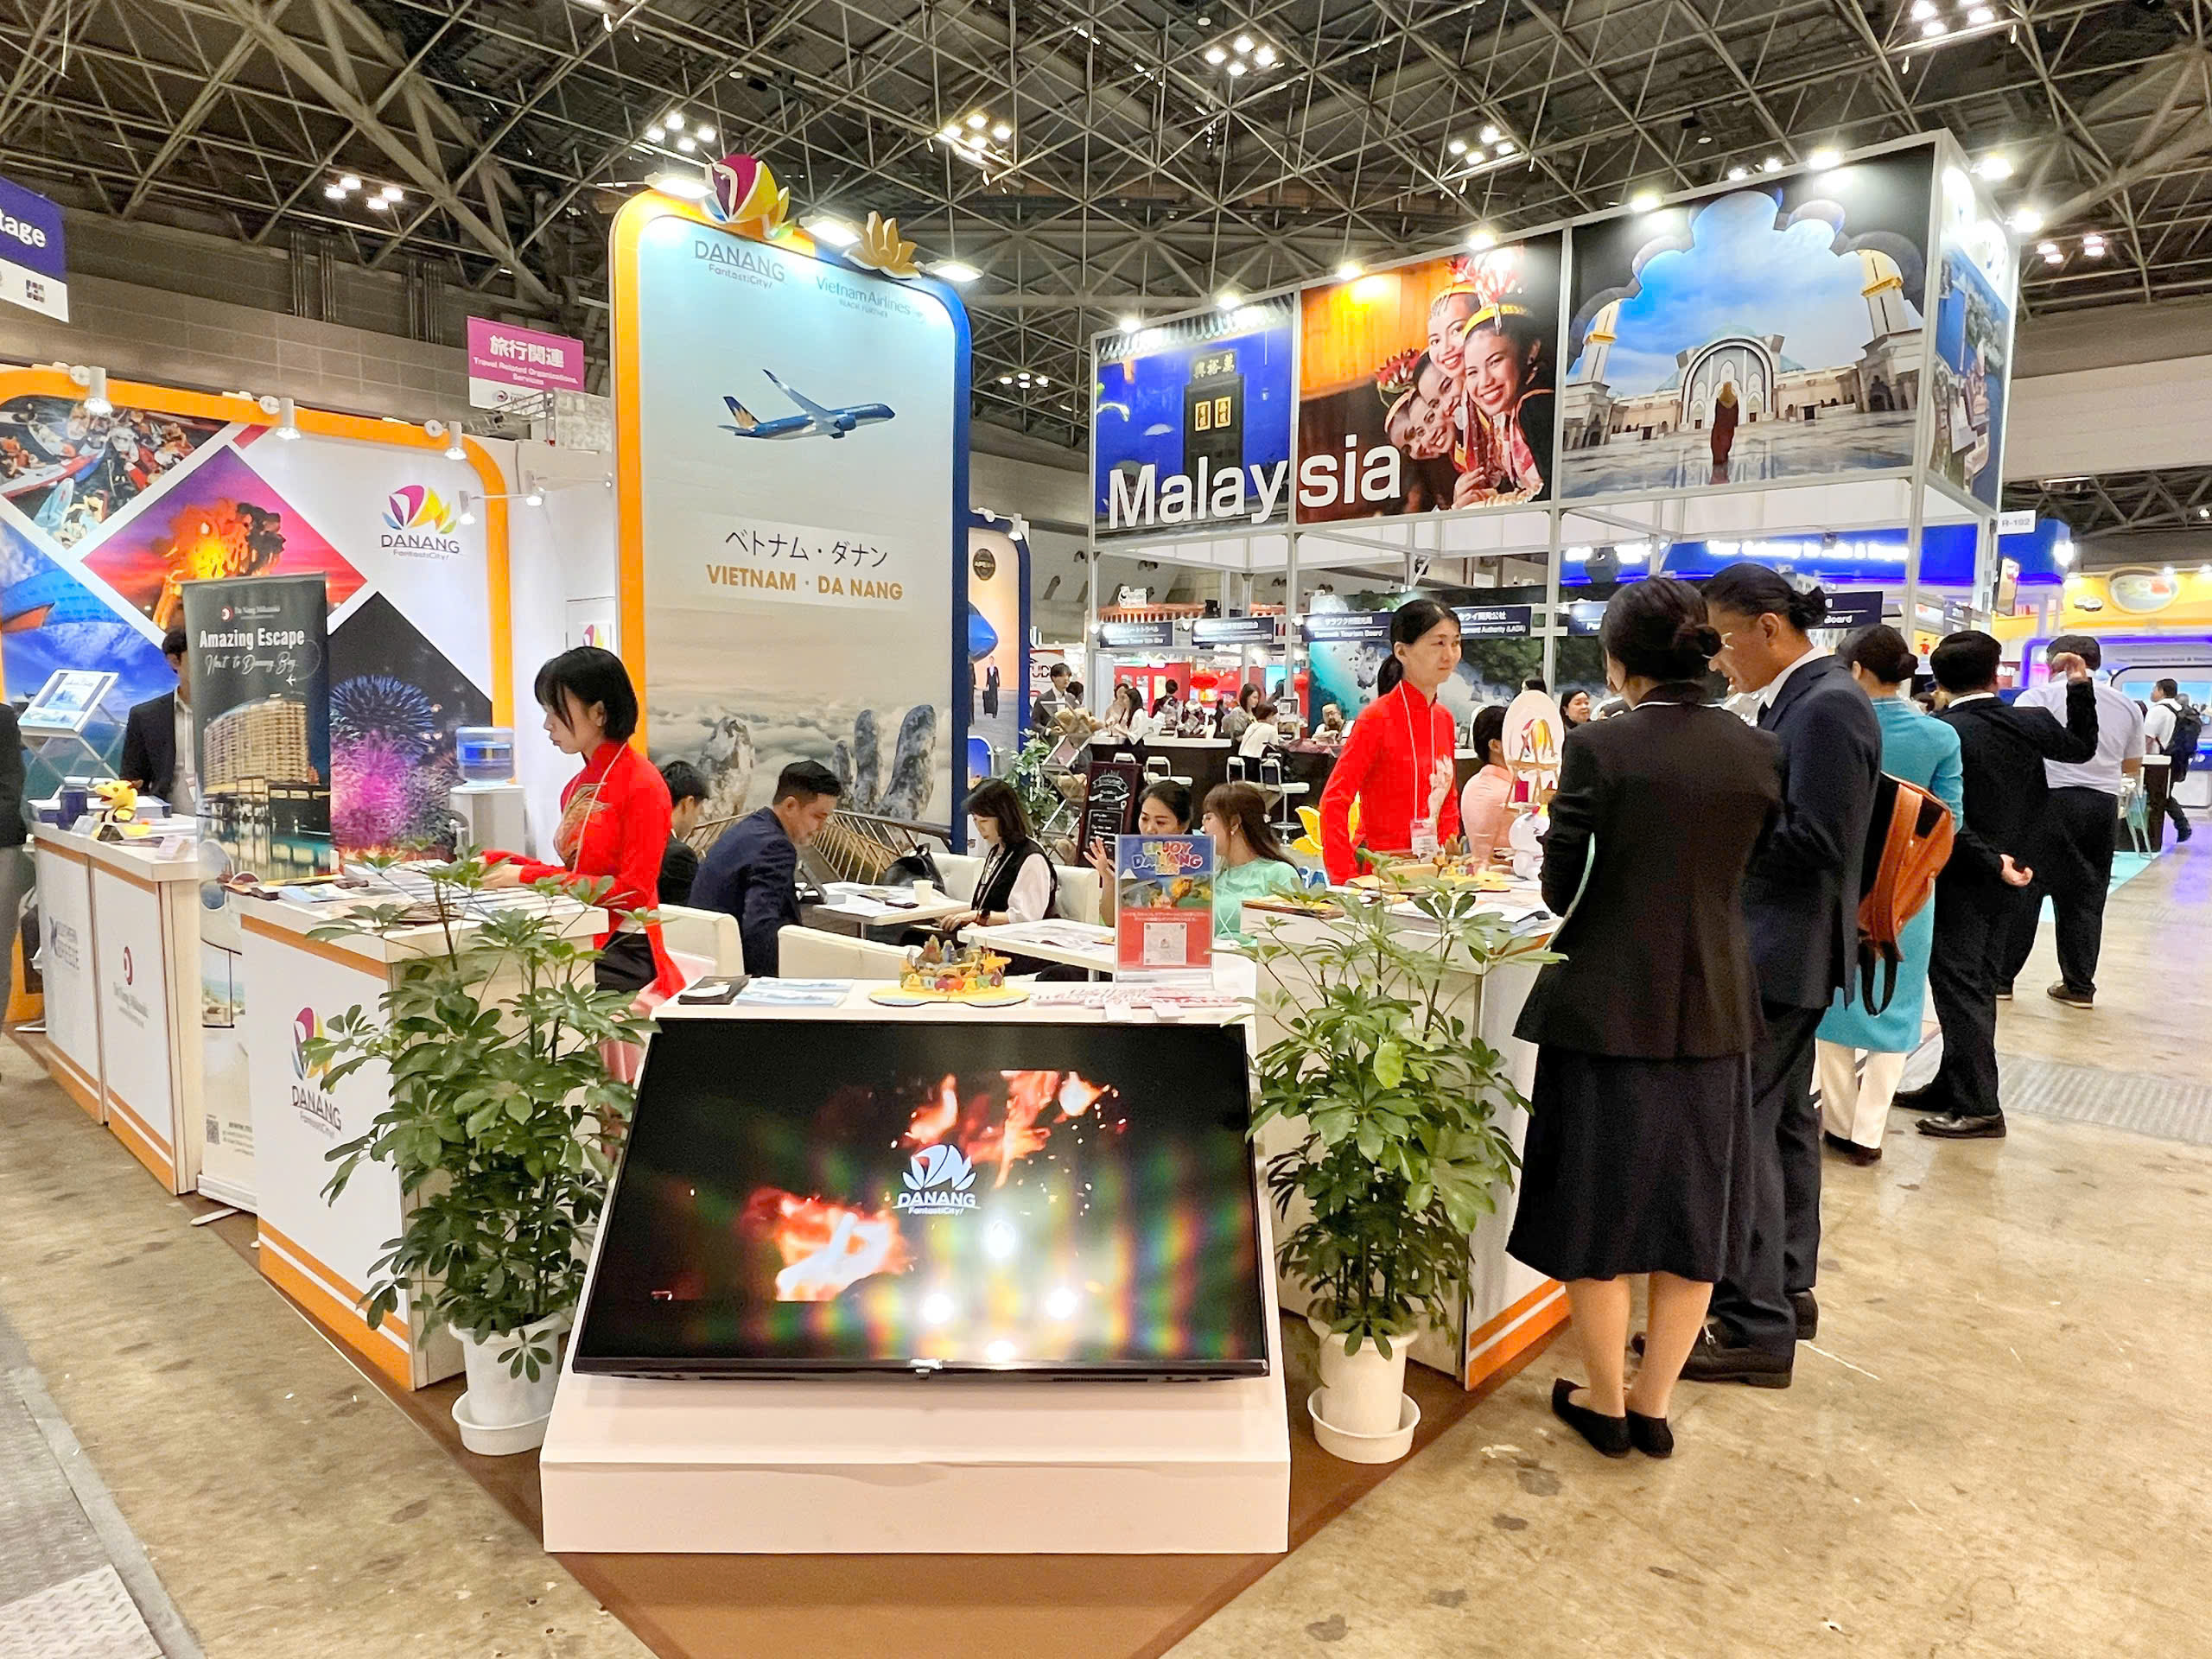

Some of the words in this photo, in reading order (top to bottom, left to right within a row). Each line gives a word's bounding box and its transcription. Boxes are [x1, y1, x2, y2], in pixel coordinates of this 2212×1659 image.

[695, 240, 785, 282] DANANG
[816, 275, 868, 302] Vietnam
[868, 291, 912, 316] Airlines
[1109, 434, 1402, 530] Malaysia
[381, 534, 461, 554] DANANG
[725, 529, 887, 568] ベトナム・ダナン
[707, 564, 796, 591] VIETNAM
[817, 575, 844, 595] DA
[850, 579, 903, 601] NANG
[199, 629, 254, 651] Amazing
[257, 627, 305, 649] Escape
[291, 1084, 342, 1132] DANANG
[898, 1191, 976, 1207] DANANG
